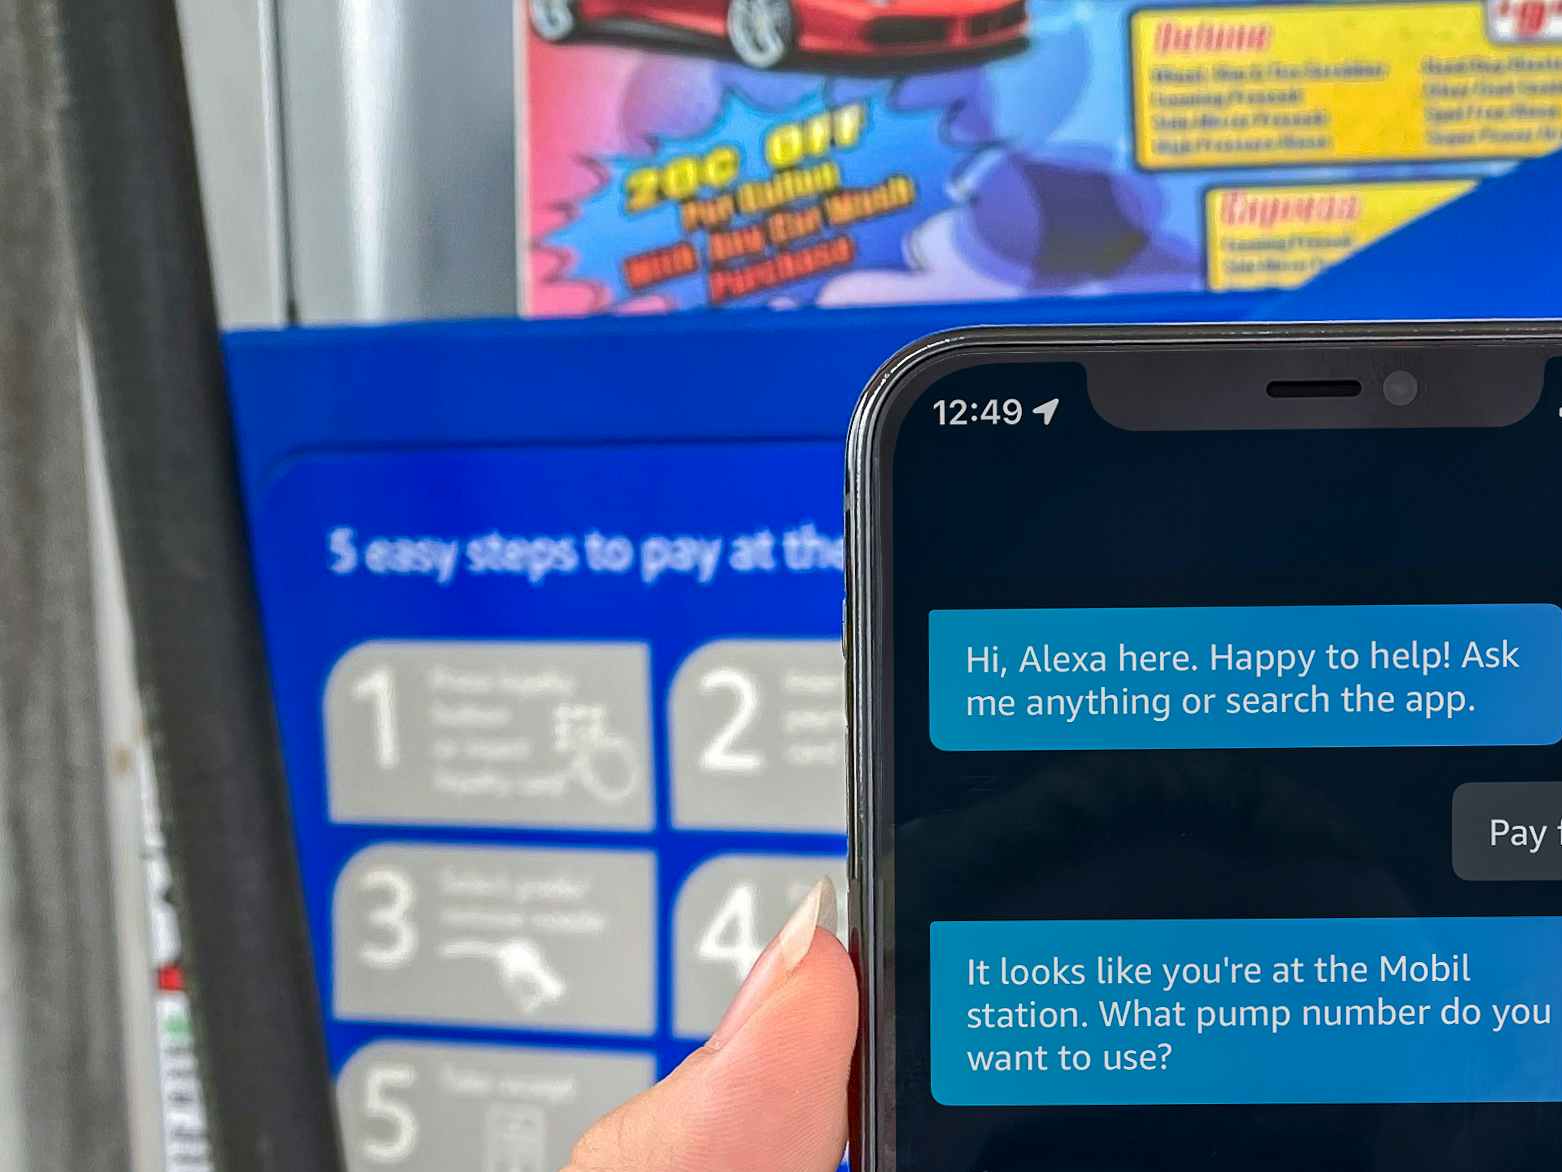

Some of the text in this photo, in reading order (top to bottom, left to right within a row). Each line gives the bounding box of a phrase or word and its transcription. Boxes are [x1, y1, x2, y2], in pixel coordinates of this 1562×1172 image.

[934, 398, 1023, 425] 12:49
[329, 527, 356, 575] 5
[365, 535, 457, 585] easy
[466, 531, 578, 586] steps
[585, 529, 634, 573] to
[641, 534, 722, 585] pay
[730, 529, 776, 574] at
[967, 639, 1520, 679] Hi, Alexa here. Happy to help! Ask
[354, 667, 396, 771] 1
[701, 666, 763, 772] 2
[967, 684, 1475, 723] me anything or search the app.
[1491, 819, 1547, 853] Pay
[360, 868, 417, 970] 3
[698, 883, 764, 982] 4
[968, 953, 1471, 992] It looks like you're at the Mobil
[967, 996, 1551, 1034] station. What pump number do you
[967, 1042, 1172, 1071] want to use?
[362, 1064, 418, 1163] 5
